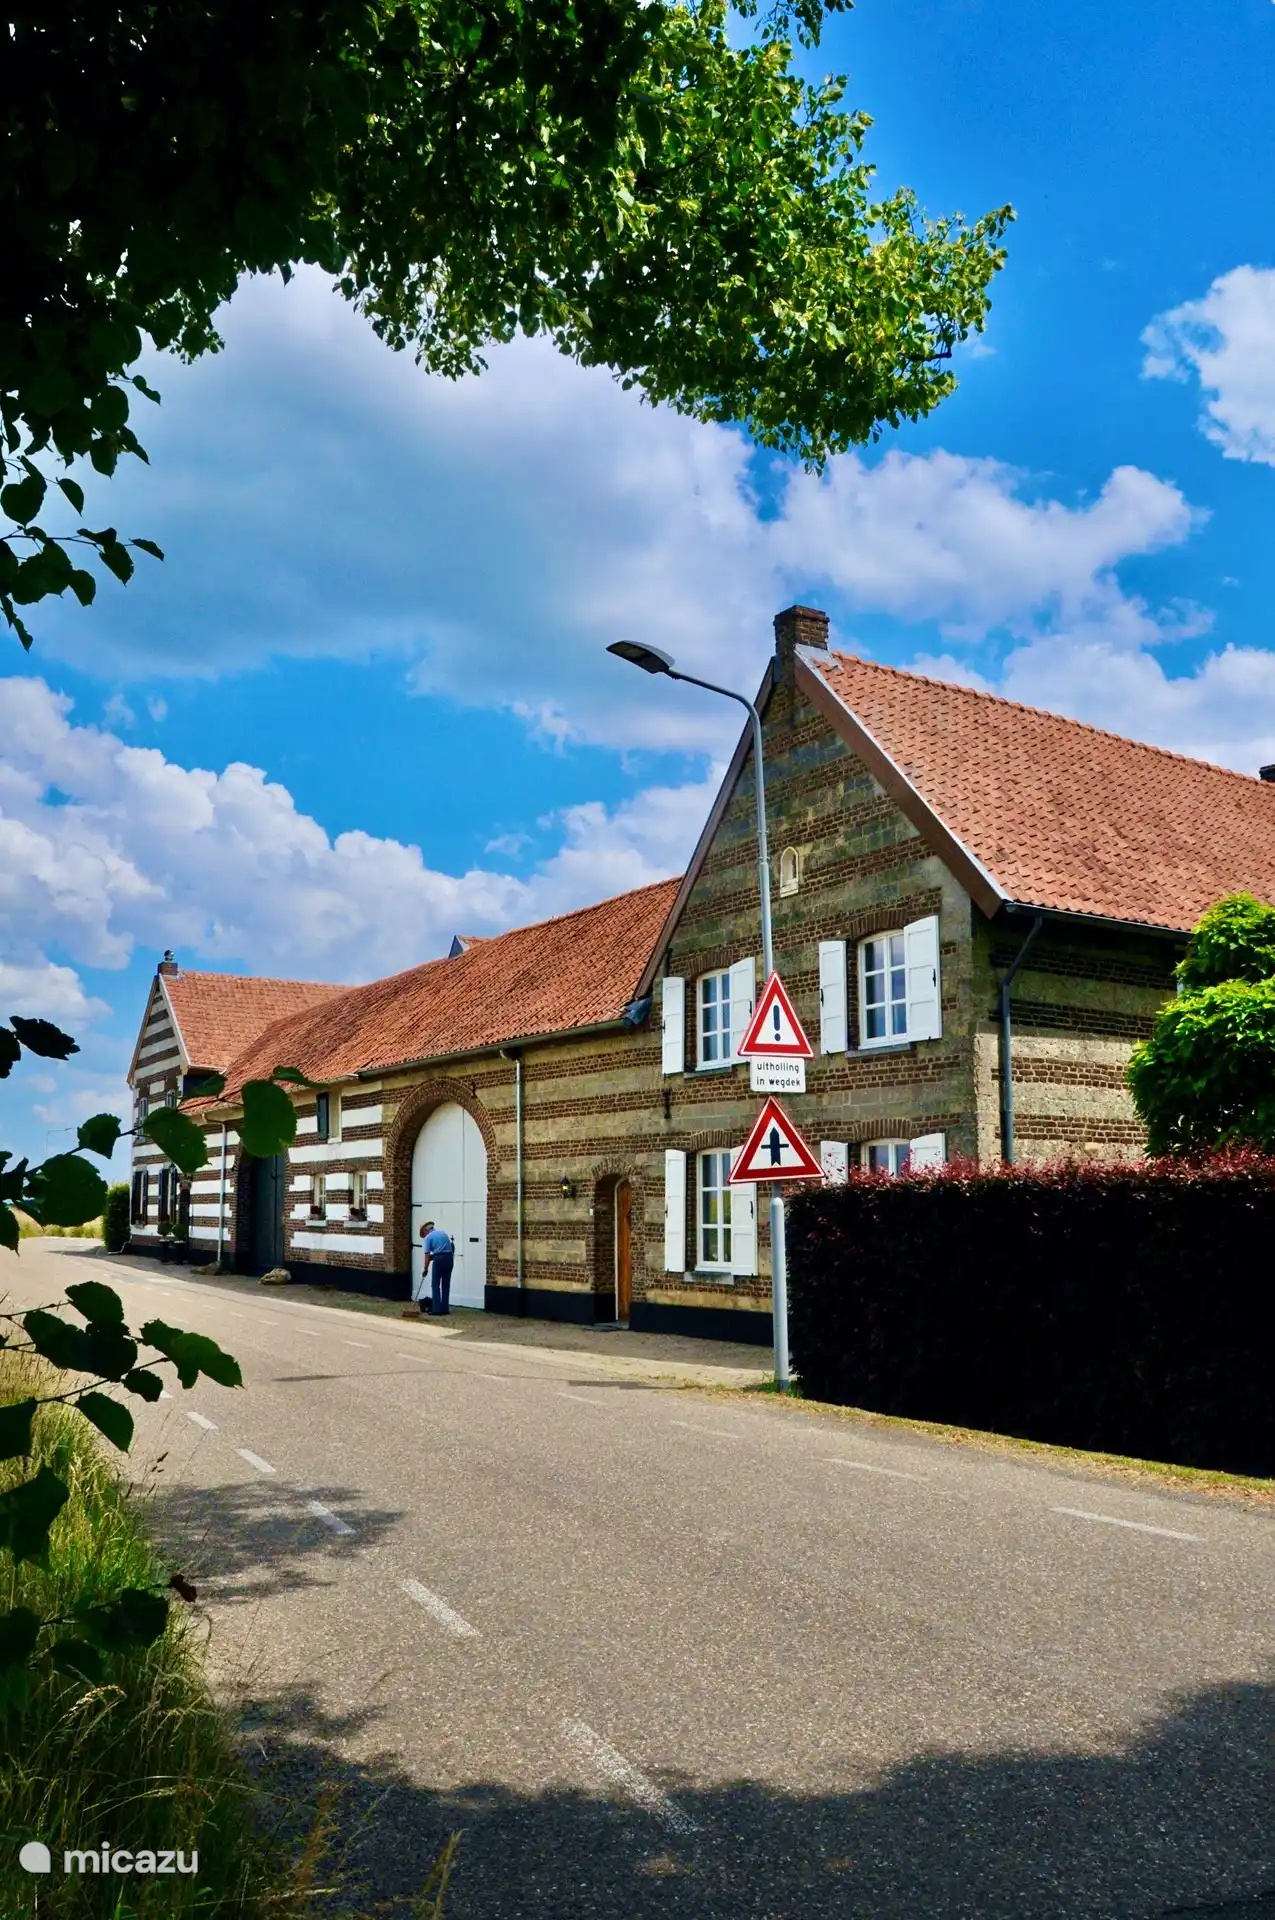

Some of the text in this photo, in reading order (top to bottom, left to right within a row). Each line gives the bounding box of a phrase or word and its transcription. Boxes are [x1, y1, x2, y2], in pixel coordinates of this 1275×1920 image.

[756, 1061, 800, 1074] uitholling
[756, 1076, 801, 1088] in wegdek
